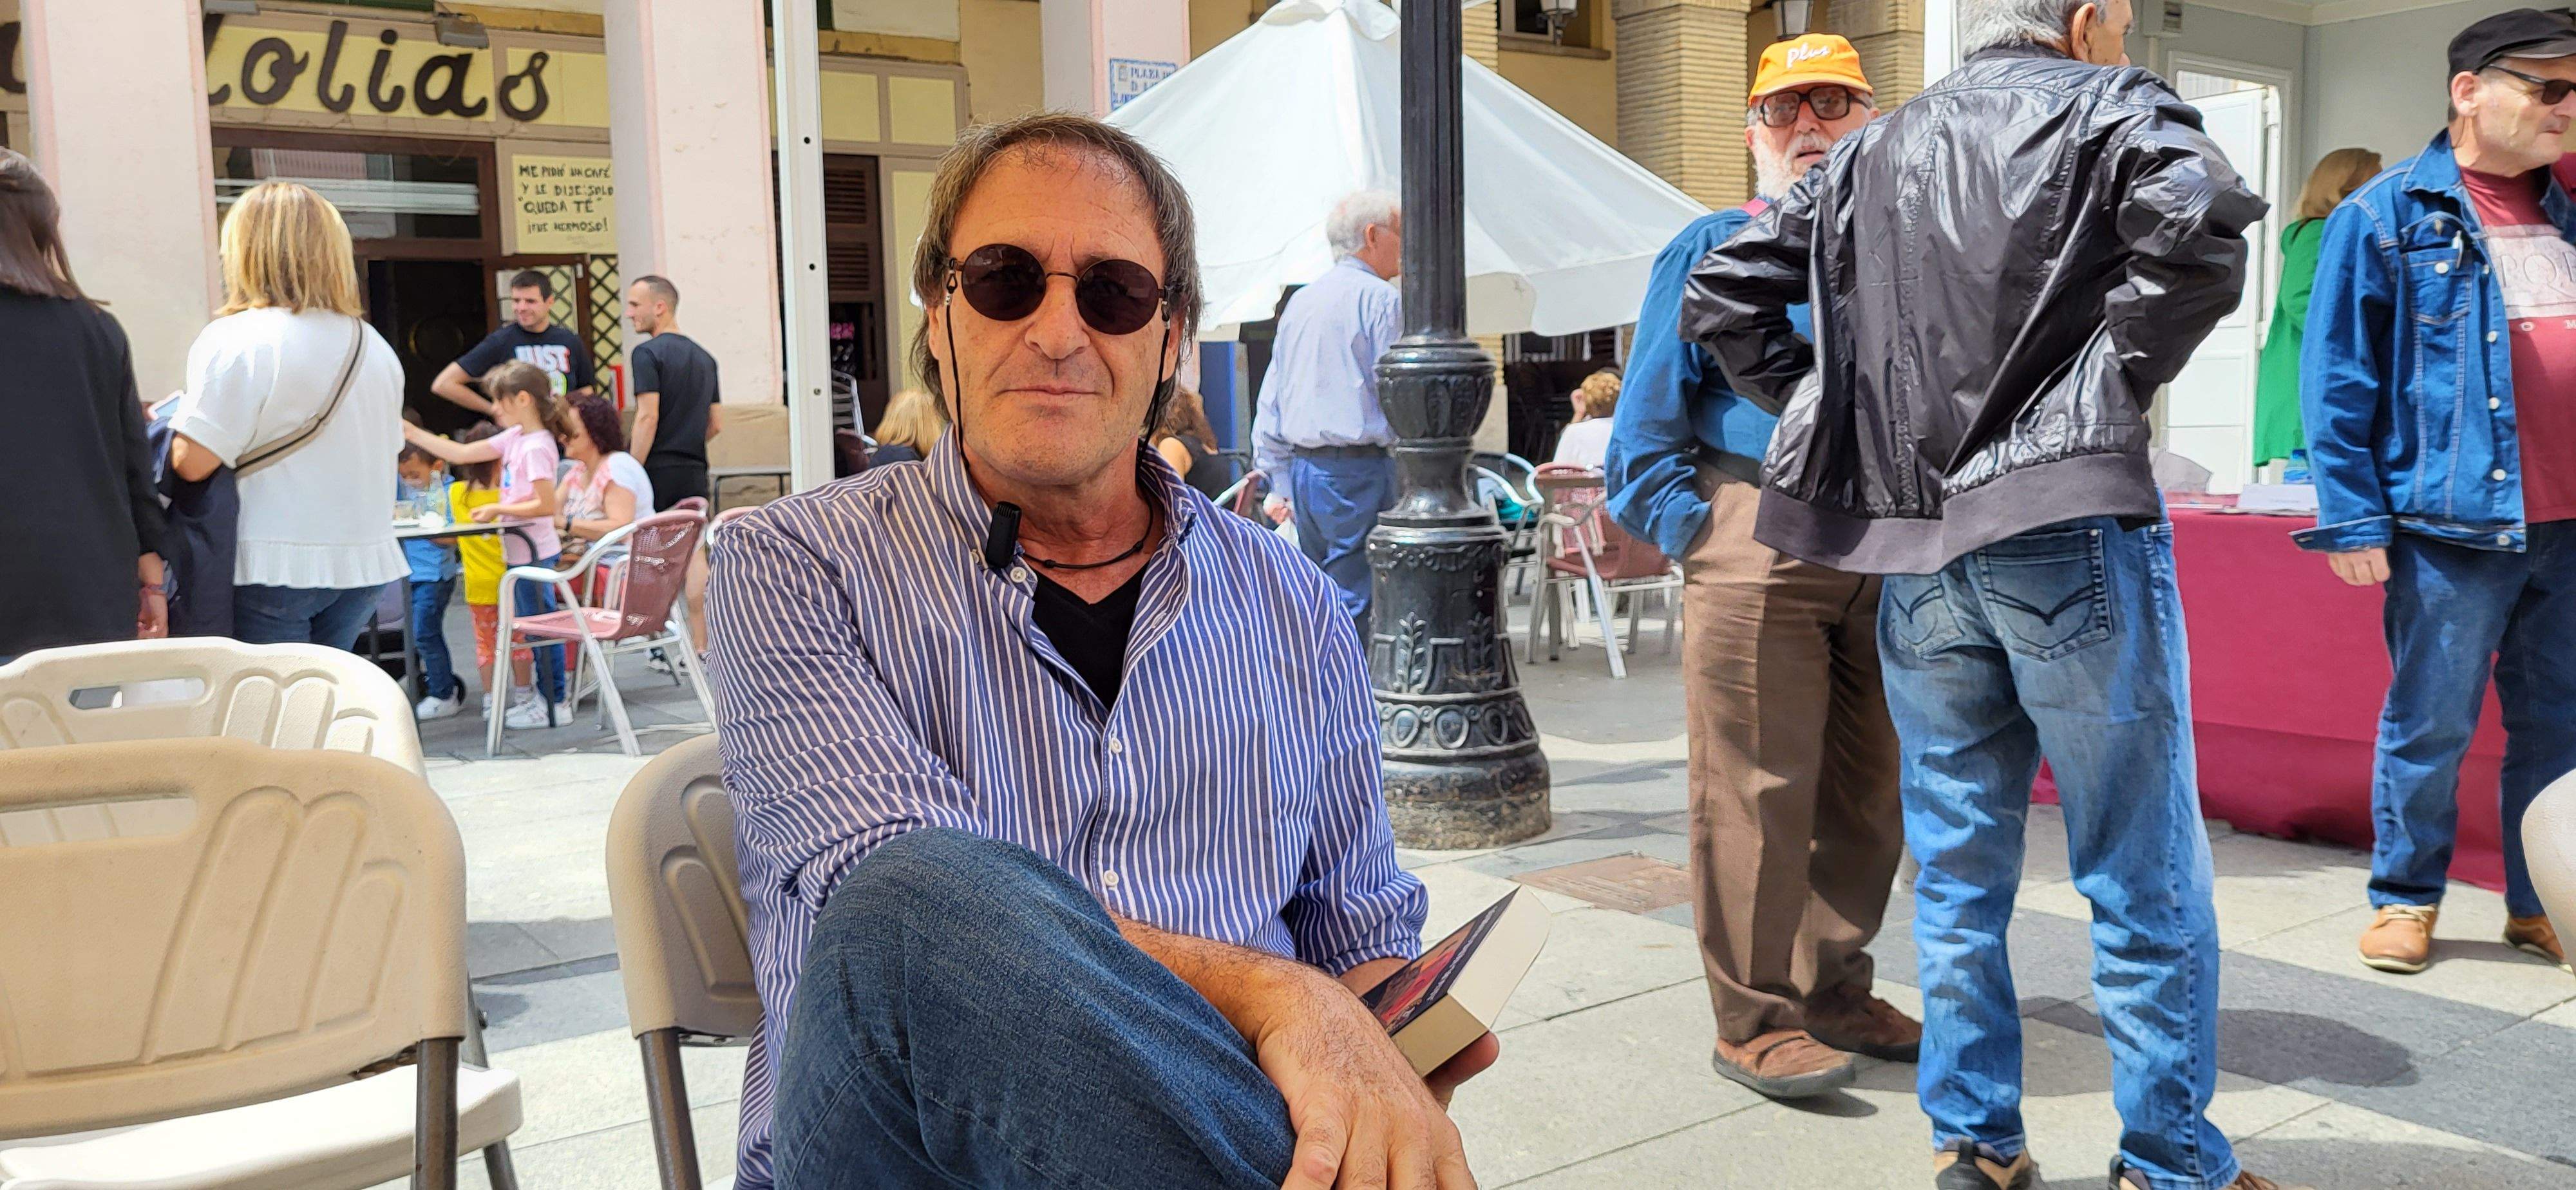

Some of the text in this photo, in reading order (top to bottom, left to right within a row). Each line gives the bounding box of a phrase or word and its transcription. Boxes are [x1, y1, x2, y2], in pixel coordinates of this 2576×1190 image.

[519, 165, 538, 177] ME
[522, 182, 529, 194] Y
[535, 184, 547, 195] LE
